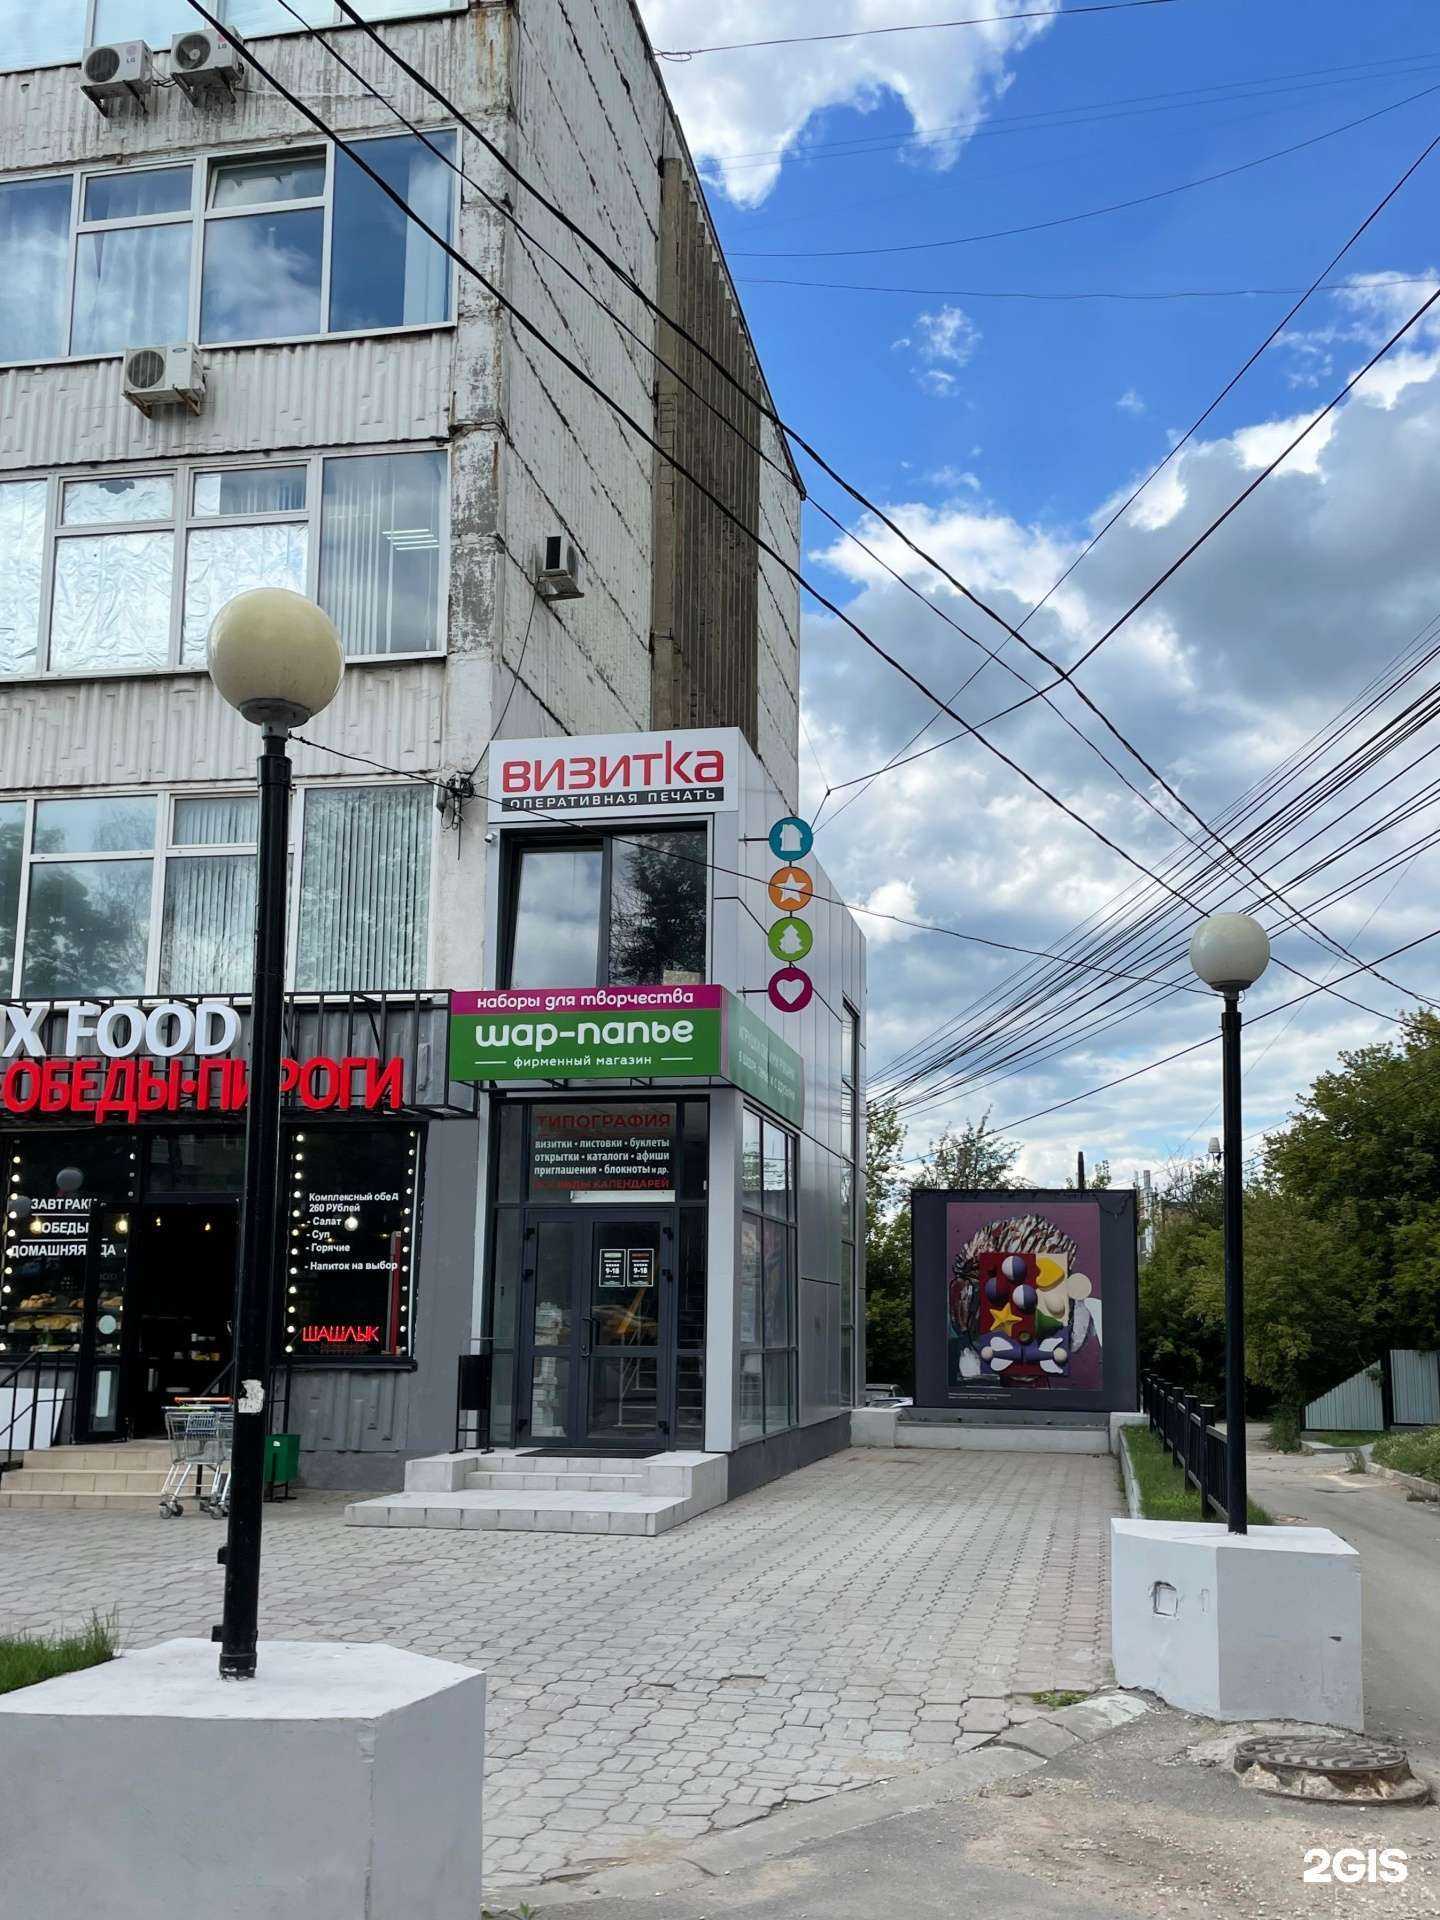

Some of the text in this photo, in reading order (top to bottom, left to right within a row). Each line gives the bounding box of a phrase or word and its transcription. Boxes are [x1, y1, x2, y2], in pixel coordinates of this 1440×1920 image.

[648, 789, 716, 804] ПЕЧАТЬ
[477, 987, 694, 1010] наборы для творчества
[65, 1003, 243, 1058] FOOD
[475, 1020, 694, 1052] шар-папье
[513, 1055, 652, 1069] фирменный магазин
[537, 1113, 671, 1129] ТИПОГРАФИЯ
[535, 1137, 670, 1150] визитки листовки буклеты
[534, 1150, 670, 1163] открытки каталоги афиши
[534, 1165, 597, 1177] приглашения
[604, 1164, 650, 1174] блокноты
[309, 1192, 373, 1202] Комплексный
[309, 1203, 325, 1212] 260
[312, 1216, 342, 1226] Салат
[41, 1222, 89, 1235] ОБЕДЫ
[311, 1229, 331, 1240] Суп
[10, 1244, 87, 1258] ДОМАШНЯЯ
[311, 1242, 351, 1253] Горячие
[310, 1260, 398, 1271] Напиток на выбор
[302, 1326, 380, 1342] ШАШЛЫК
